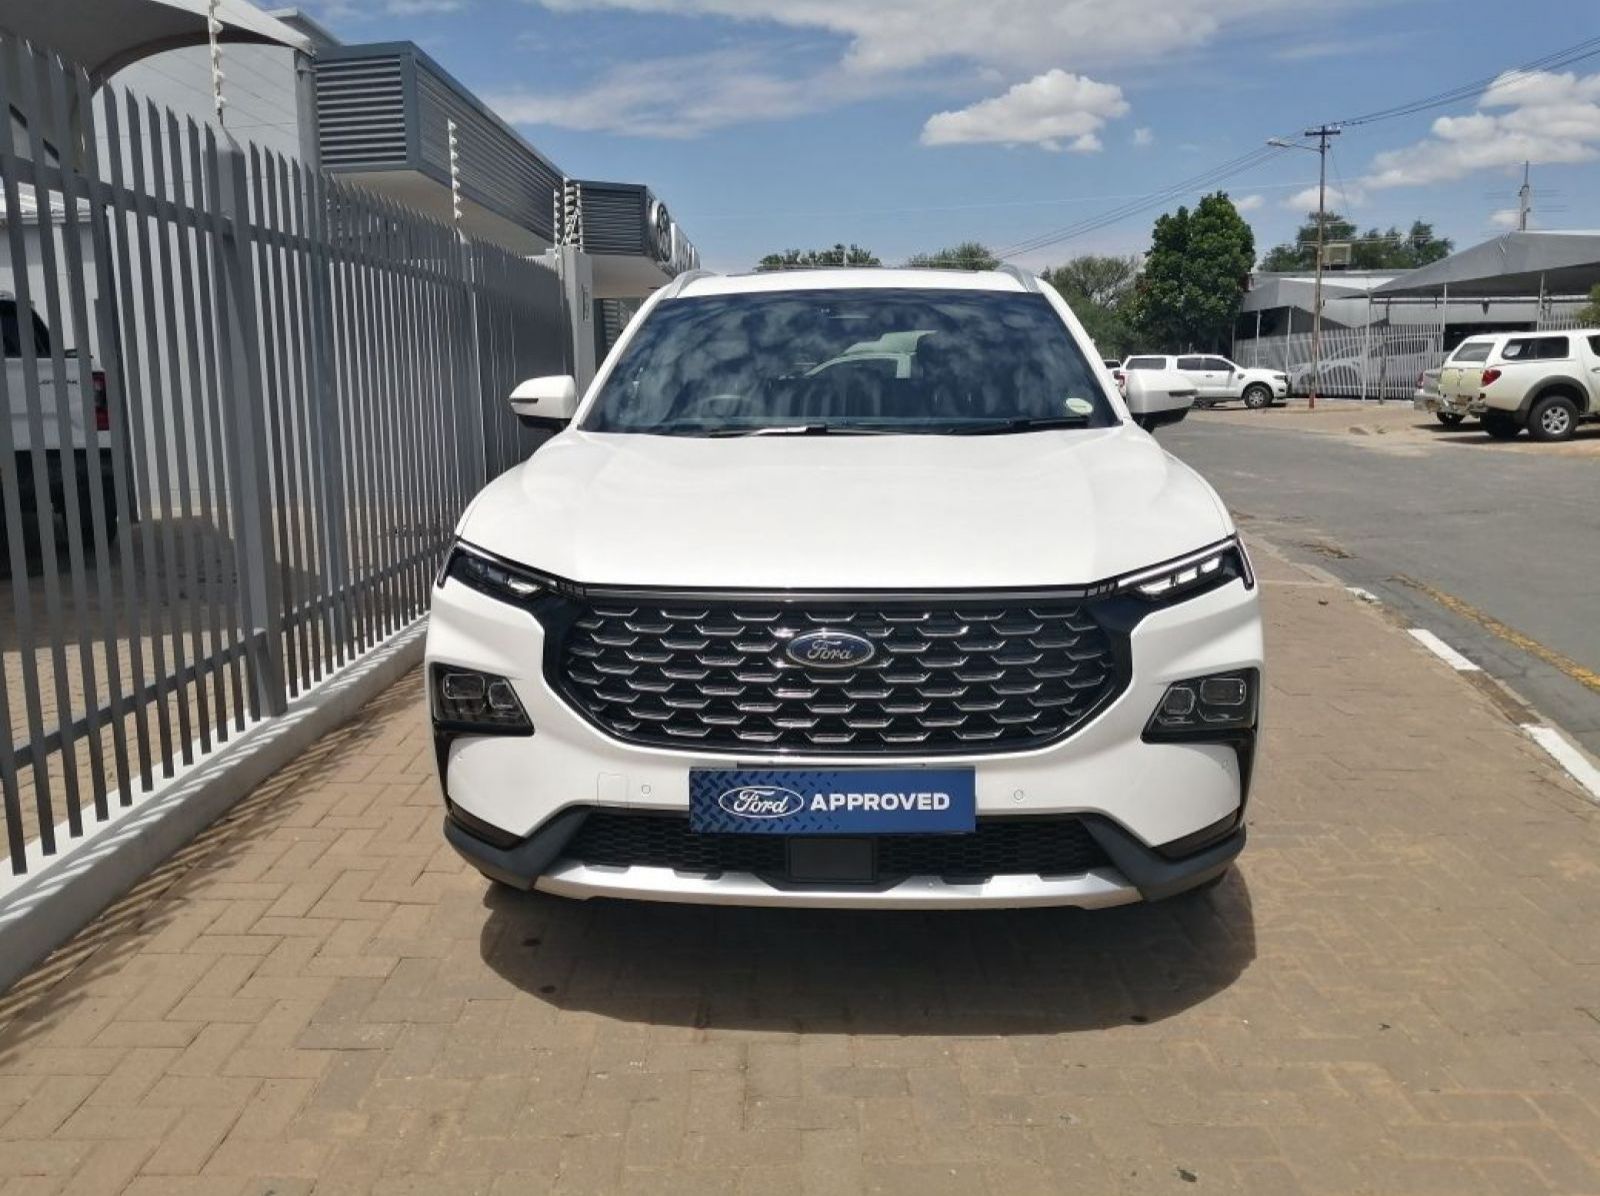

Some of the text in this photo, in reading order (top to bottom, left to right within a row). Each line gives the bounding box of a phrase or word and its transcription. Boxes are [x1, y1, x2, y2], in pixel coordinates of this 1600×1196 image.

[807, 639, 853, 660] Ford
[733, 788, 950, 814] Ford APPROVED
